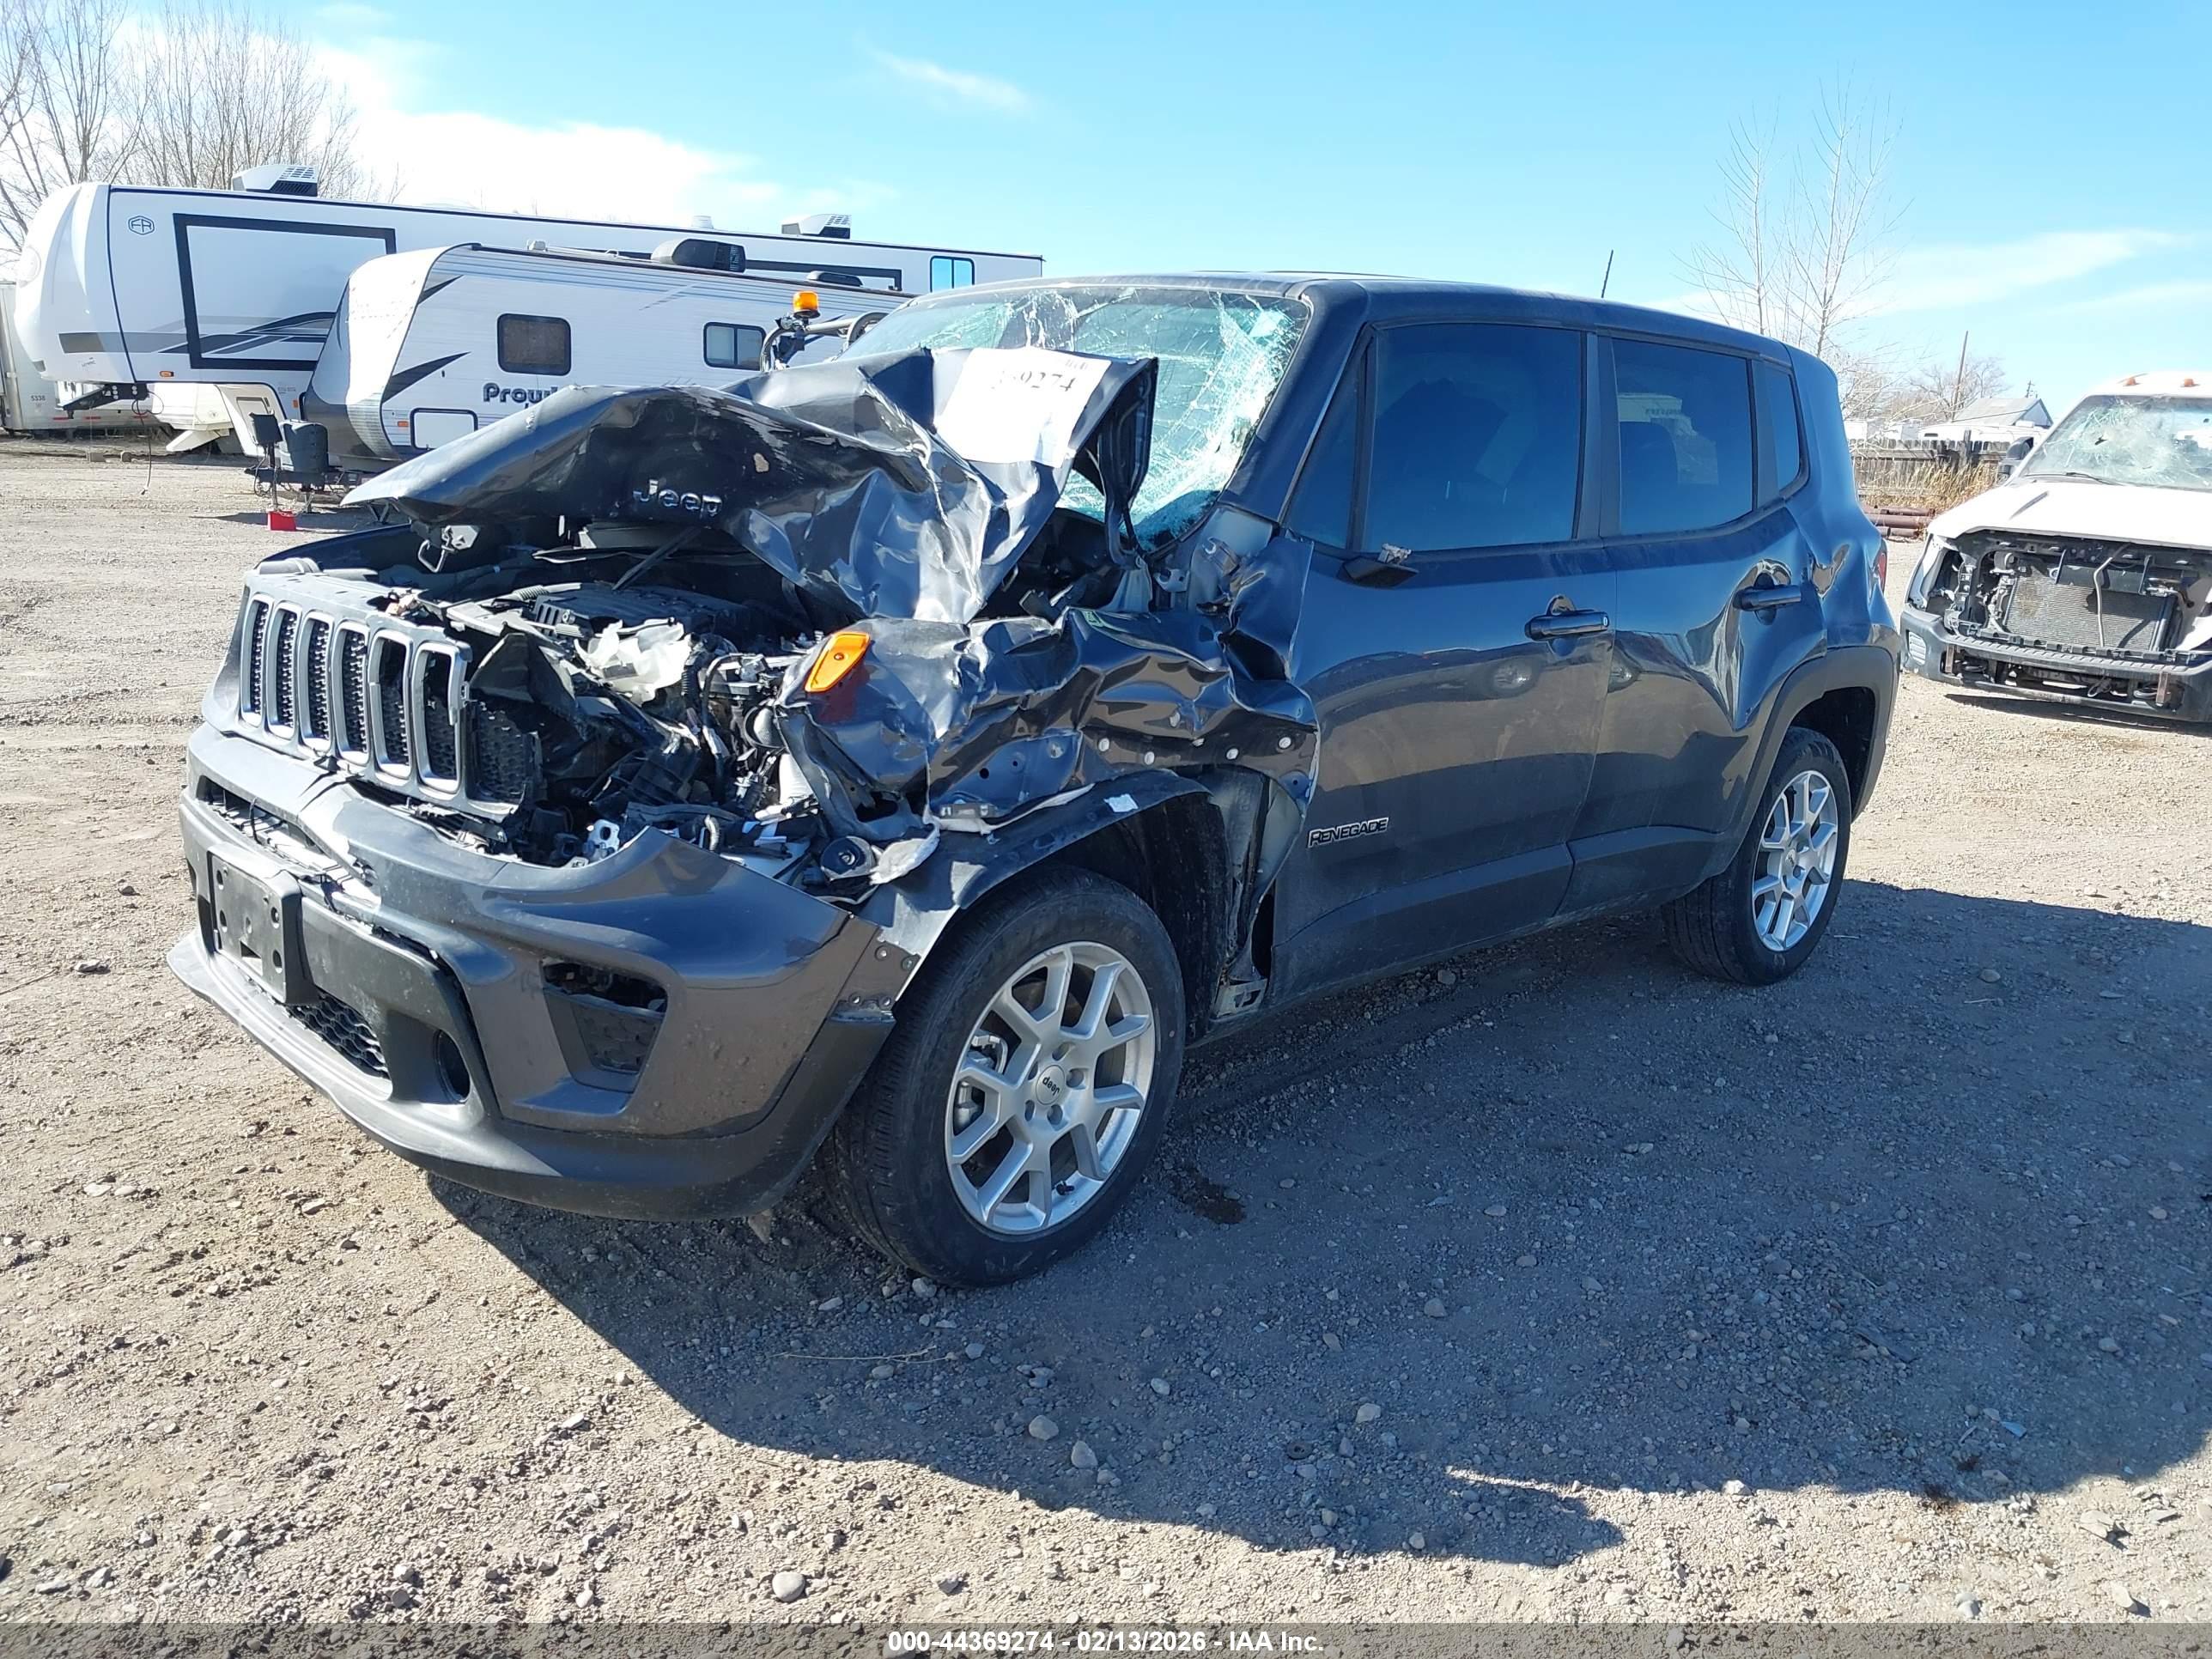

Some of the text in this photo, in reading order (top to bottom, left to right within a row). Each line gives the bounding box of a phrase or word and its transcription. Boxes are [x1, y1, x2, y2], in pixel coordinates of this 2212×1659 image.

[633, 479, 722, 519] Jeep
[1307, 817, 1389, 848] RENEGADE
[1042, 1076, 1060, 1097] Jeep
